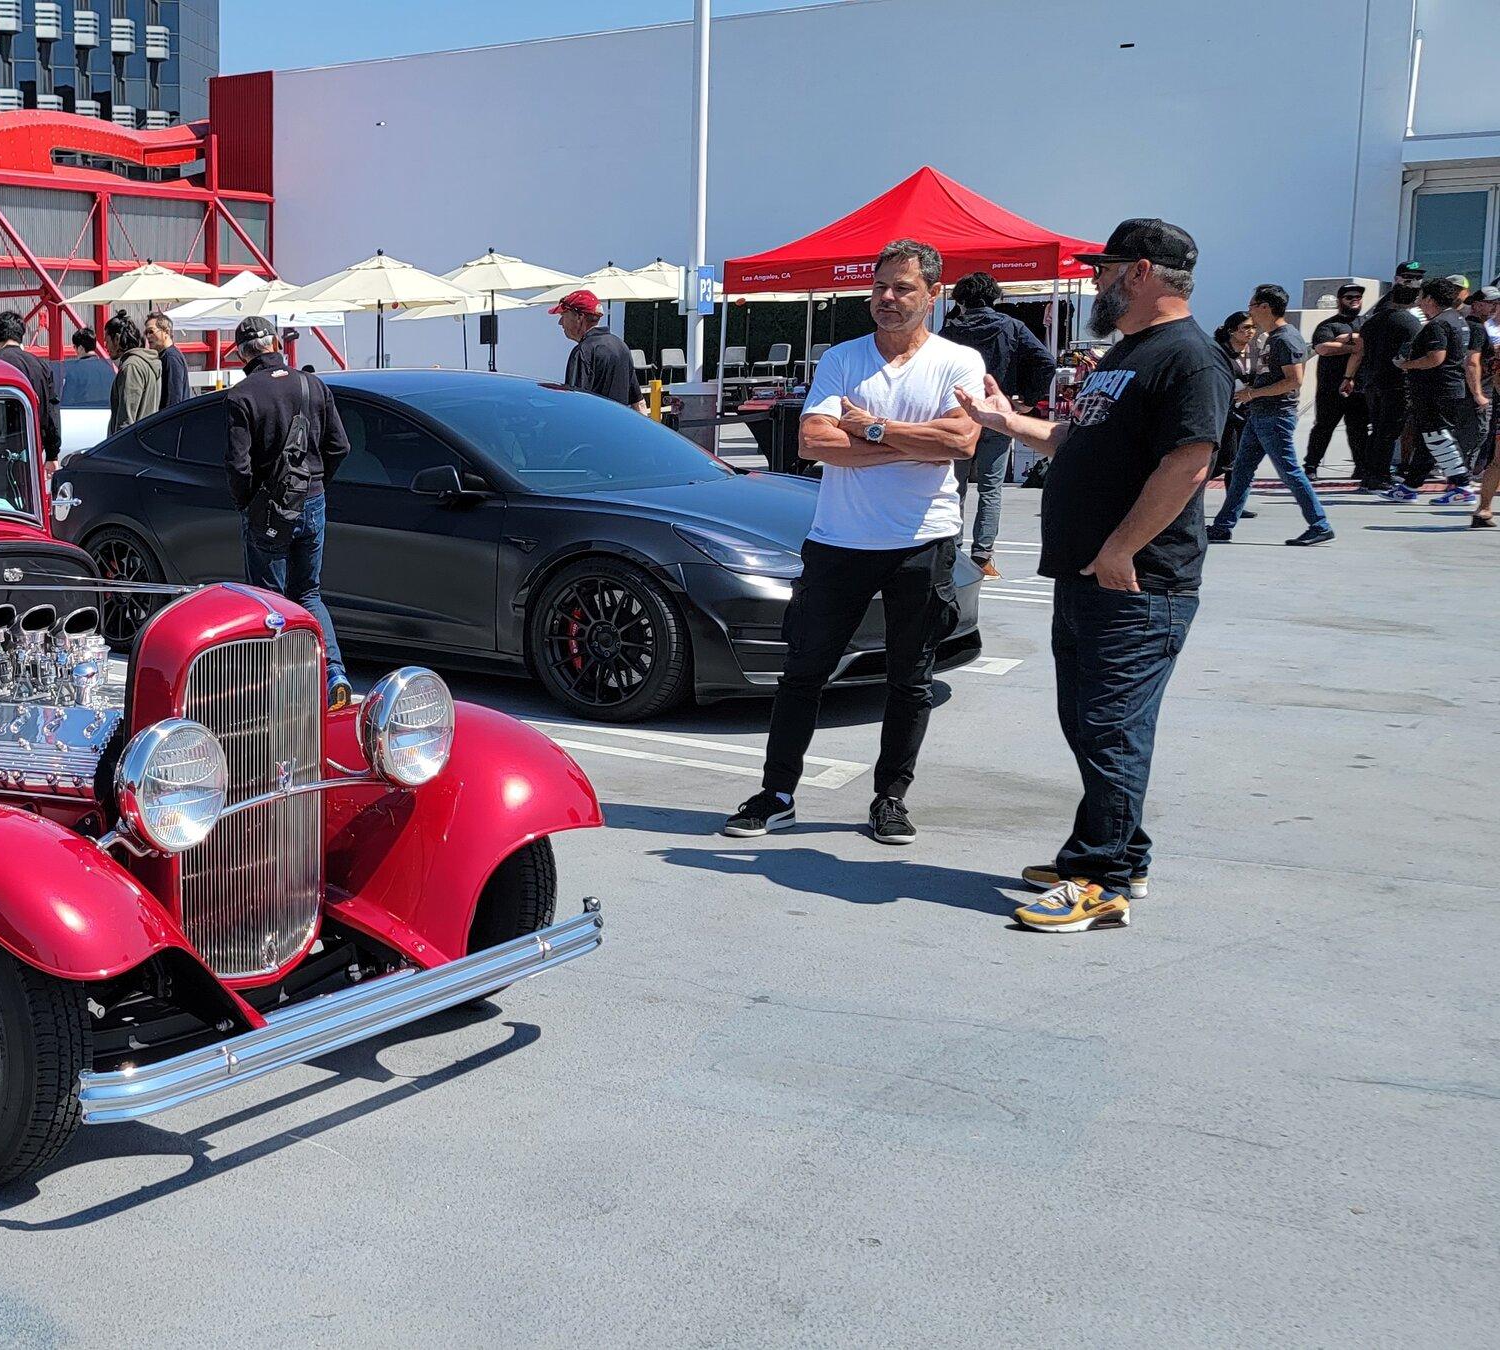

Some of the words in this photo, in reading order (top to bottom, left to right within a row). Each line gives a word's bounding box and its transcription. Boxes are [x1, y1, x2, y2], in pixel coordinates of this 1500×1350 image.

[834, 262, 877, 275] PETE
[992, 261, 1037, 270] petersen.org
[700, 278, 712, 302] P3
